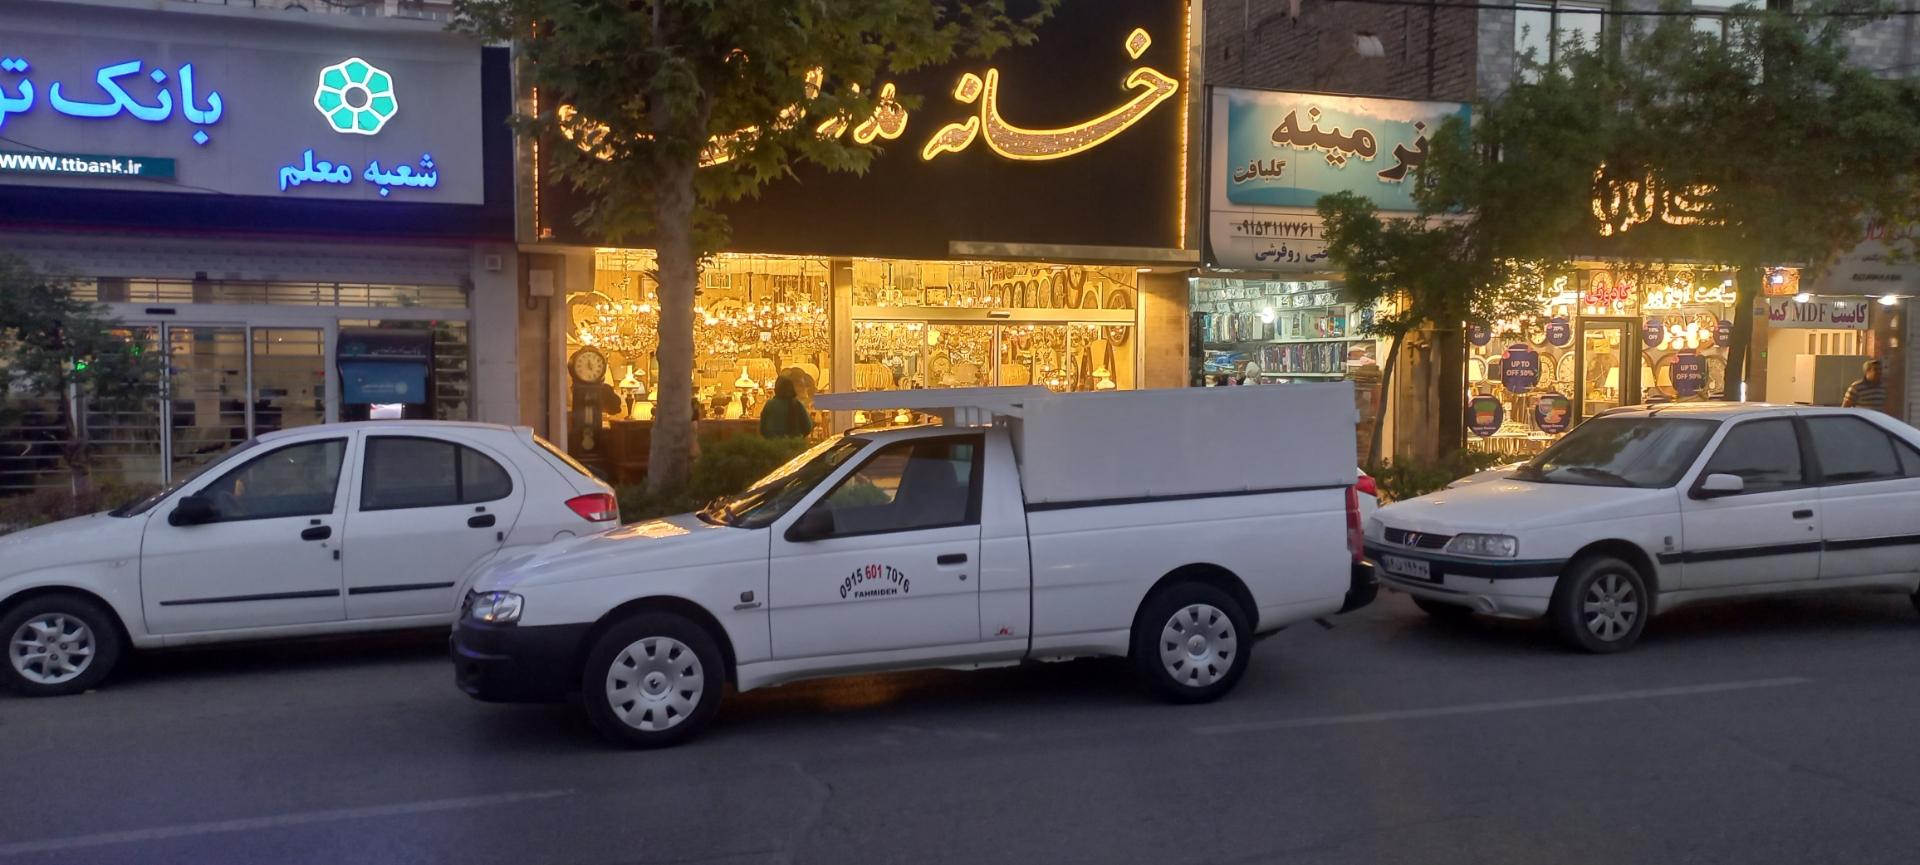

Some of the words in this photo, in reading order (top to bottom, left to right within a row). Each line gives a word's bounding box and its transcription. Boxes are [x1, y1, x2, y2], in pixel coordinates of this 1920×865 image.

[49, 60, 223, 145] بانک
[922, 27, 1180, 160] خانه
[1272, 106, 1428, 180] نرمینه
[279, 150, 352, 191] معلم
[363, 153, 437, 197] شعبه
[1233, 159, 1286, 183] گلبافت
[1255, 241, 1301, 263] روفرشی
[1792, 302, 1827, 322] MDF
[1506, 369, 1519, 377] OFF
[840, 567, 863, 600] 0915
[865, 563, 882, 580] 601
[886, 565, 910, 594] 7076
[854, 588, 897, 598] FAHMIDEH
